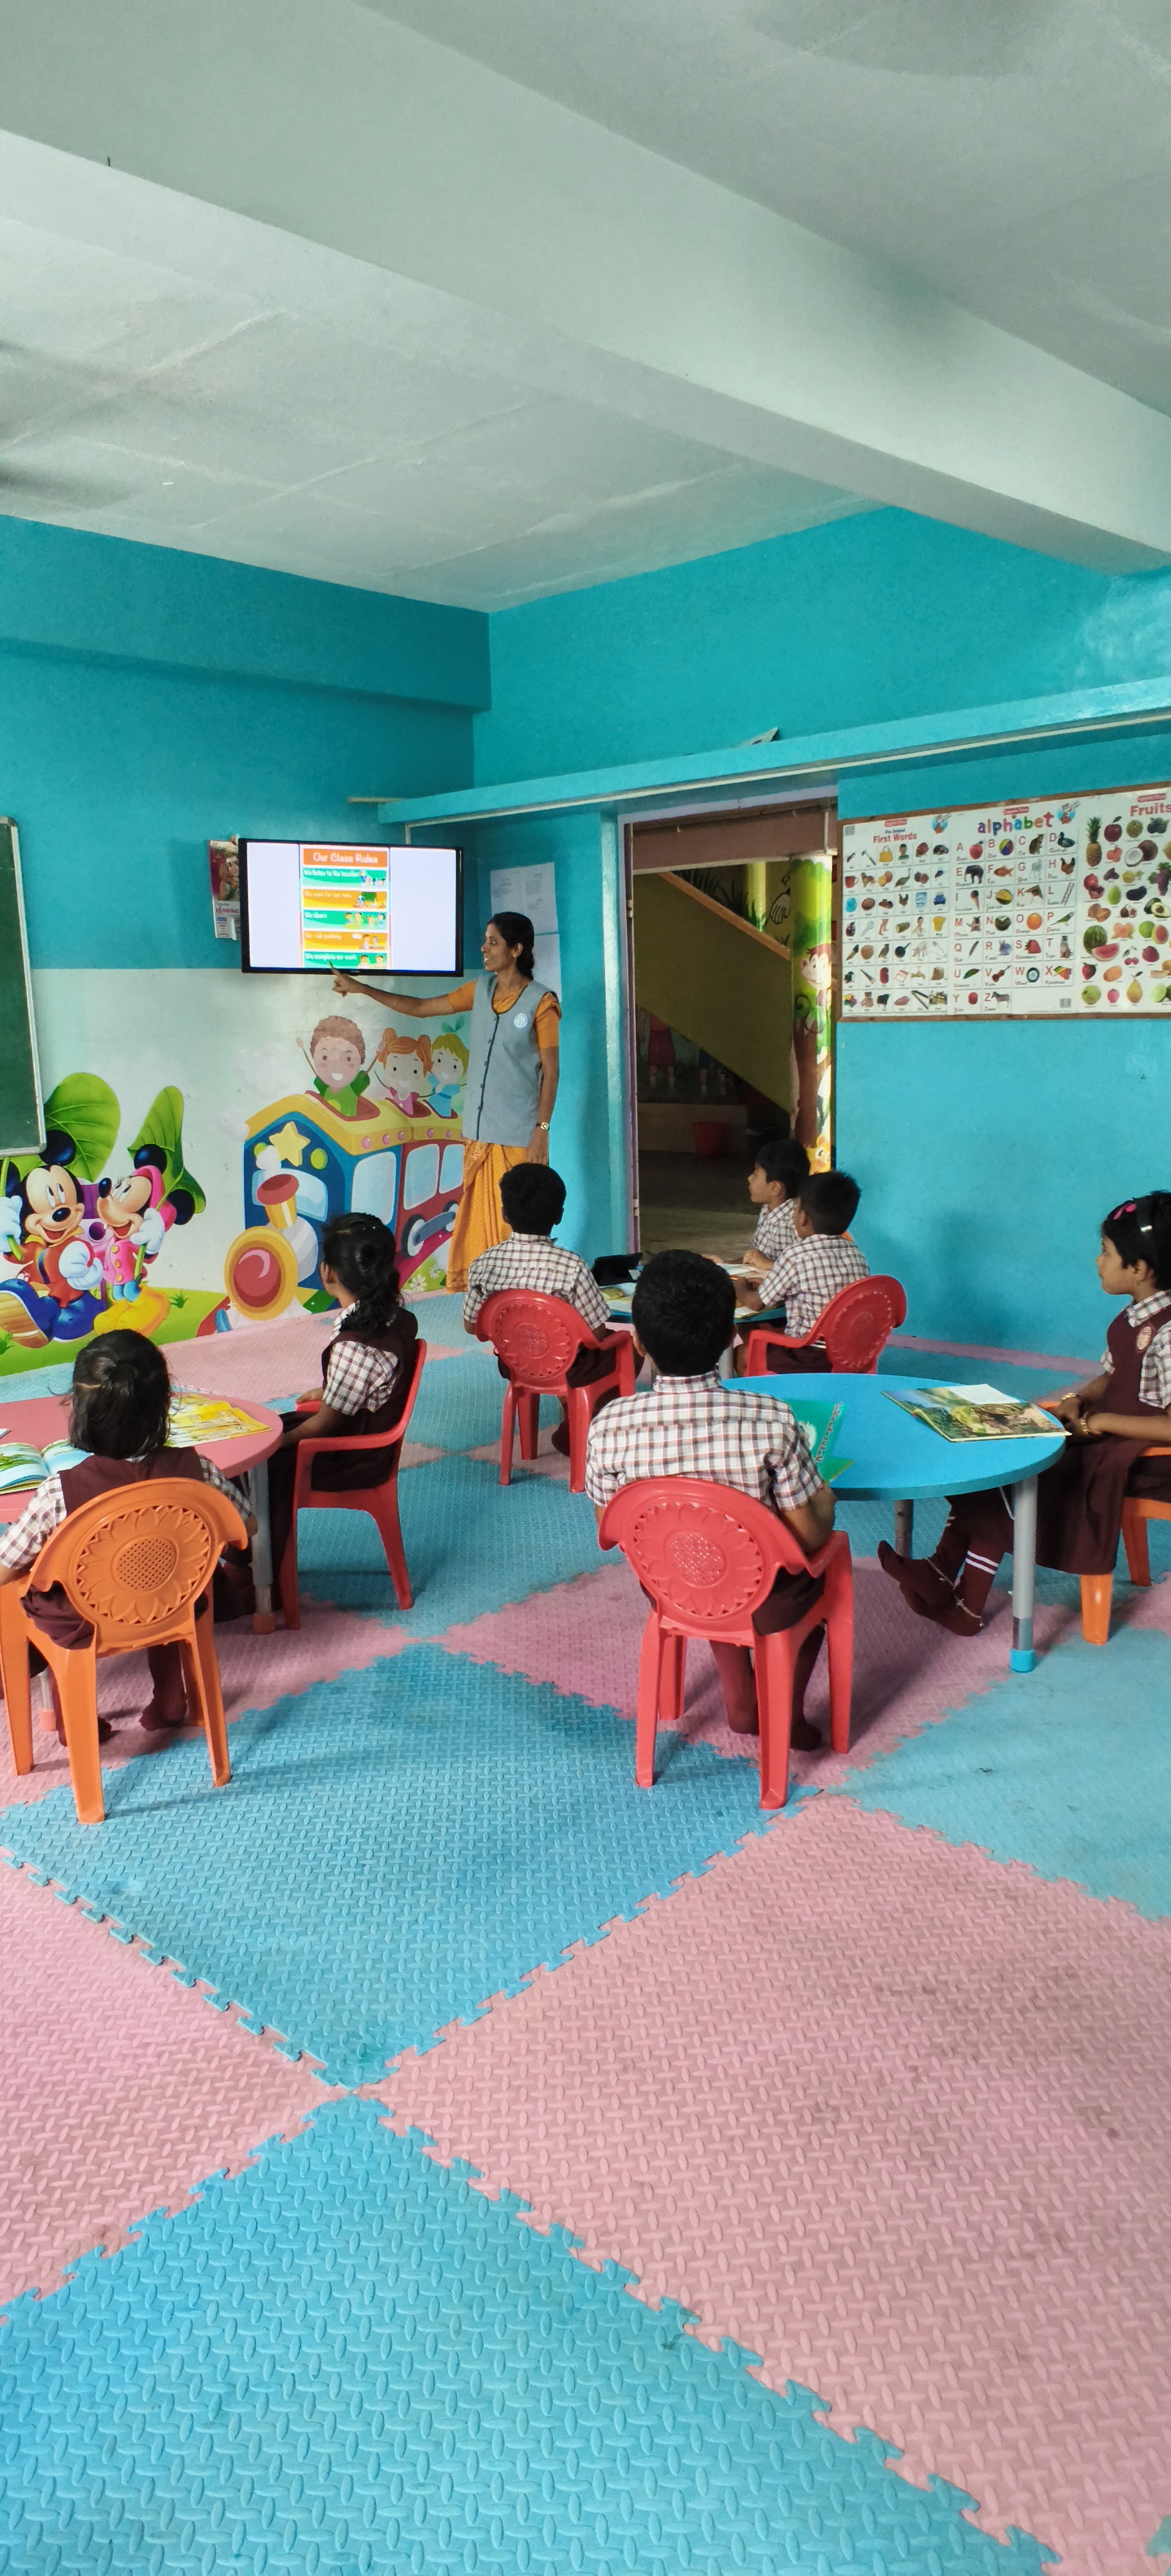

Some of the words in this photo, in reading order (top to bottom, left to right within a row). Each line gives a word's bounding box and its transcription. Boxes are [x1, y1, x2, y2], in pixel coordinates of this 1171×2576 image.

[1130, 803, 1171, 817] Fruits
[977, 812, 1055, 836] alphabet
[873, 834, 891, 844] First
[893, 832, 917, 842] Words
[1018, 836, 1026, 846] C
[1049, 833, 1057, 842] D
[956, 842, 964, 851] A
[988, 838, 995, 848] B
[312, 852, 328, 862] Our
[330, 852, 354, 863] Class
[355, 853, 378, 864] Rules
[987, 864, 995, 873] F
[1017, 862, 1026, 871] G
[1048, 859, 1056, 868] H
[956, 867, 963, 877] E
[986, 890, 993, 899] J
[1016, 887, 1025, 897] K
[1047, 886, 1055, 894] L
[986, 916, 994, 925] N
[1016, 913, 1024, 923] O
[1047, 912, 1054, 920] P
[955, 917, 963, 927] M
[954, 942, 962, 952] Q
[985, 941, 993, 951] R
[1016, 939, 1022, 949] S
[1046, 938, 1054, 947] T
[954, 968, 961, 978] U
[985, 968, 992, 977] V
[1015, 966, 1025, 976] W
[1045, 965, 1053, 976] X
[953, 994, 960, 1003] Y
[984, 993, 991, 1002] Z
